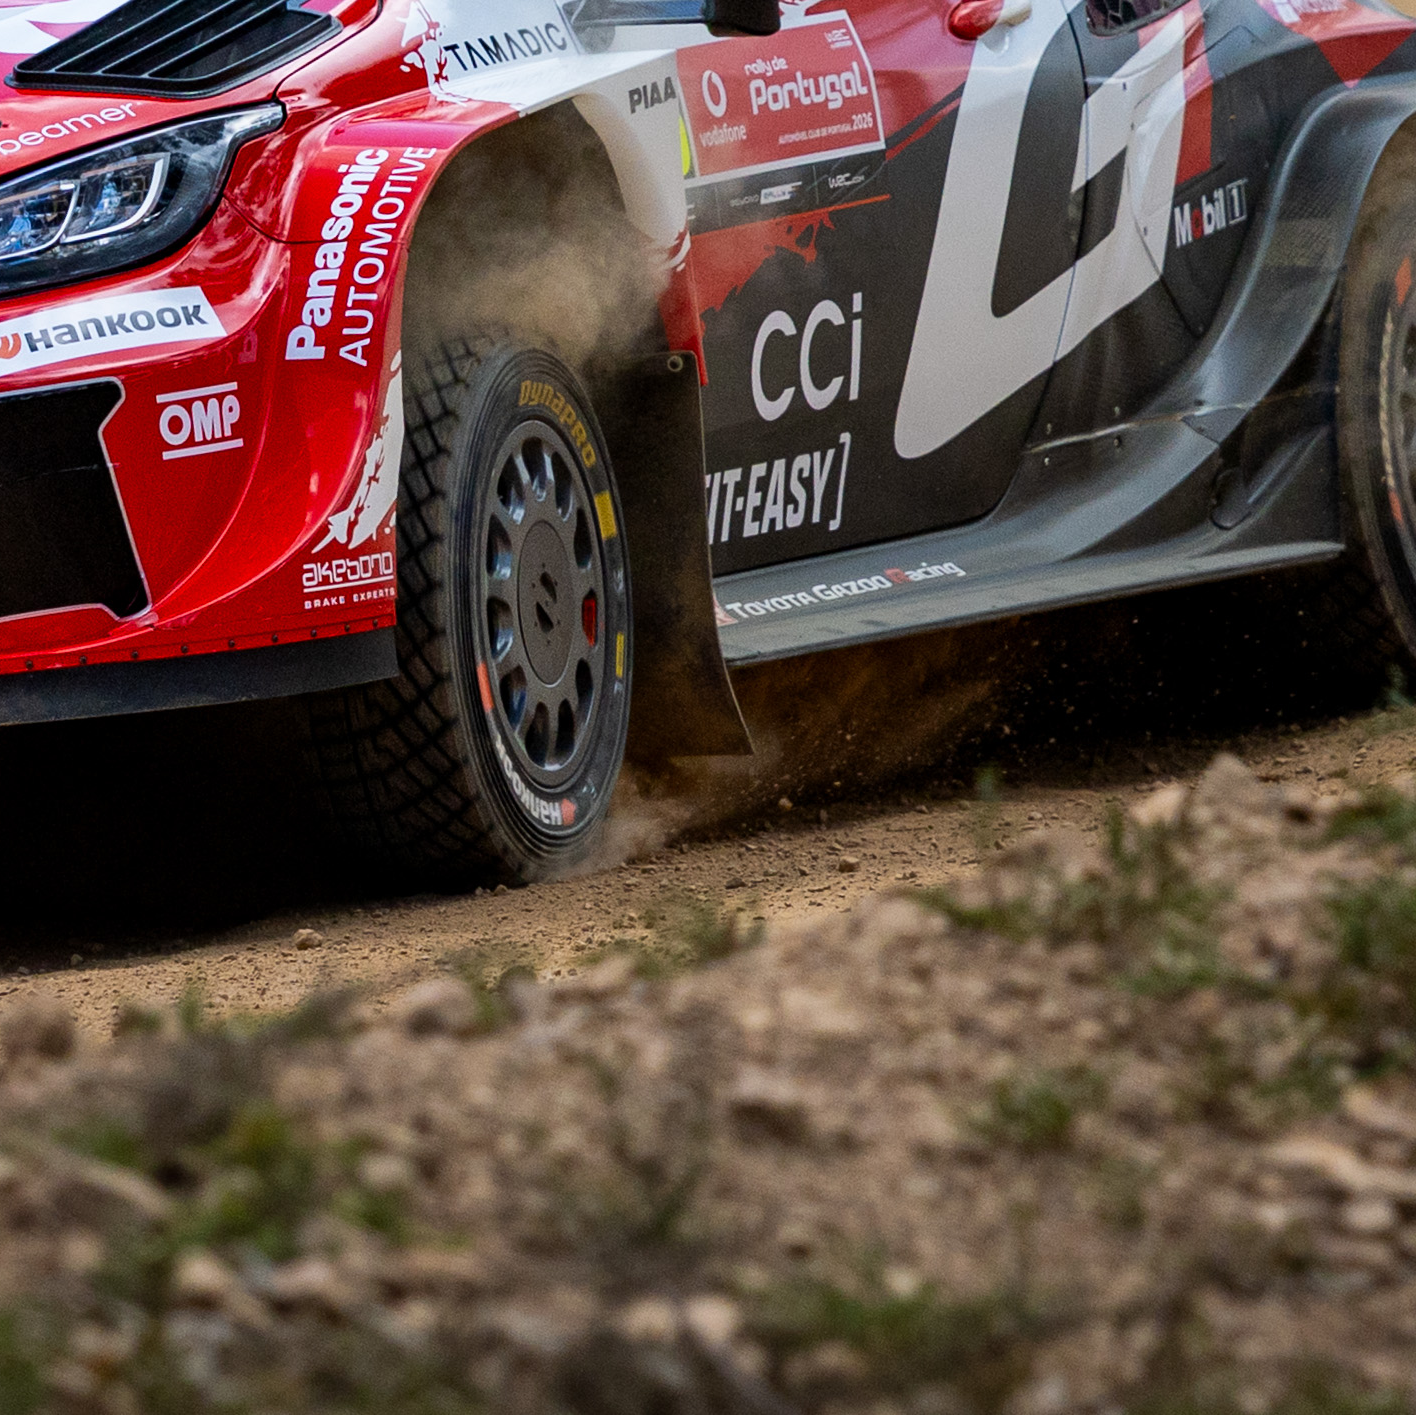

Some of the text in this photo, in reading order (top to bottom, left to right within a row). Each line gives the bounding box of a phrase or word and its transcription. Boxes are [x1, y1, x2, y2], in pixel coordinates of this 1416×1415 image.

[444, 22, 568, 72] TAMADIC
[744, 56, 789, 77] rally de
[628, 76, 677, 114] PIAA
[749, 61, 869, 115] Portugal
[699, 122, 747, 148] vodafone
[852, 112, 874, 129] 2026
[1174, 187, 1226, 249] Mobil
[285, 148, 389, 361] Panasonic
[339, 147, 437, 367] AUTOMOTIVE
[159, 395, 241, 447] OMP
[302, 551, 394, 587] akebono
[725, 591, 818, 620] TOYOTA
[812, 575, 893, 602] GAZOO
[885, 562, 966, 584] Racing
[304, 587, 396, 609] BRAKE EXPERTS
